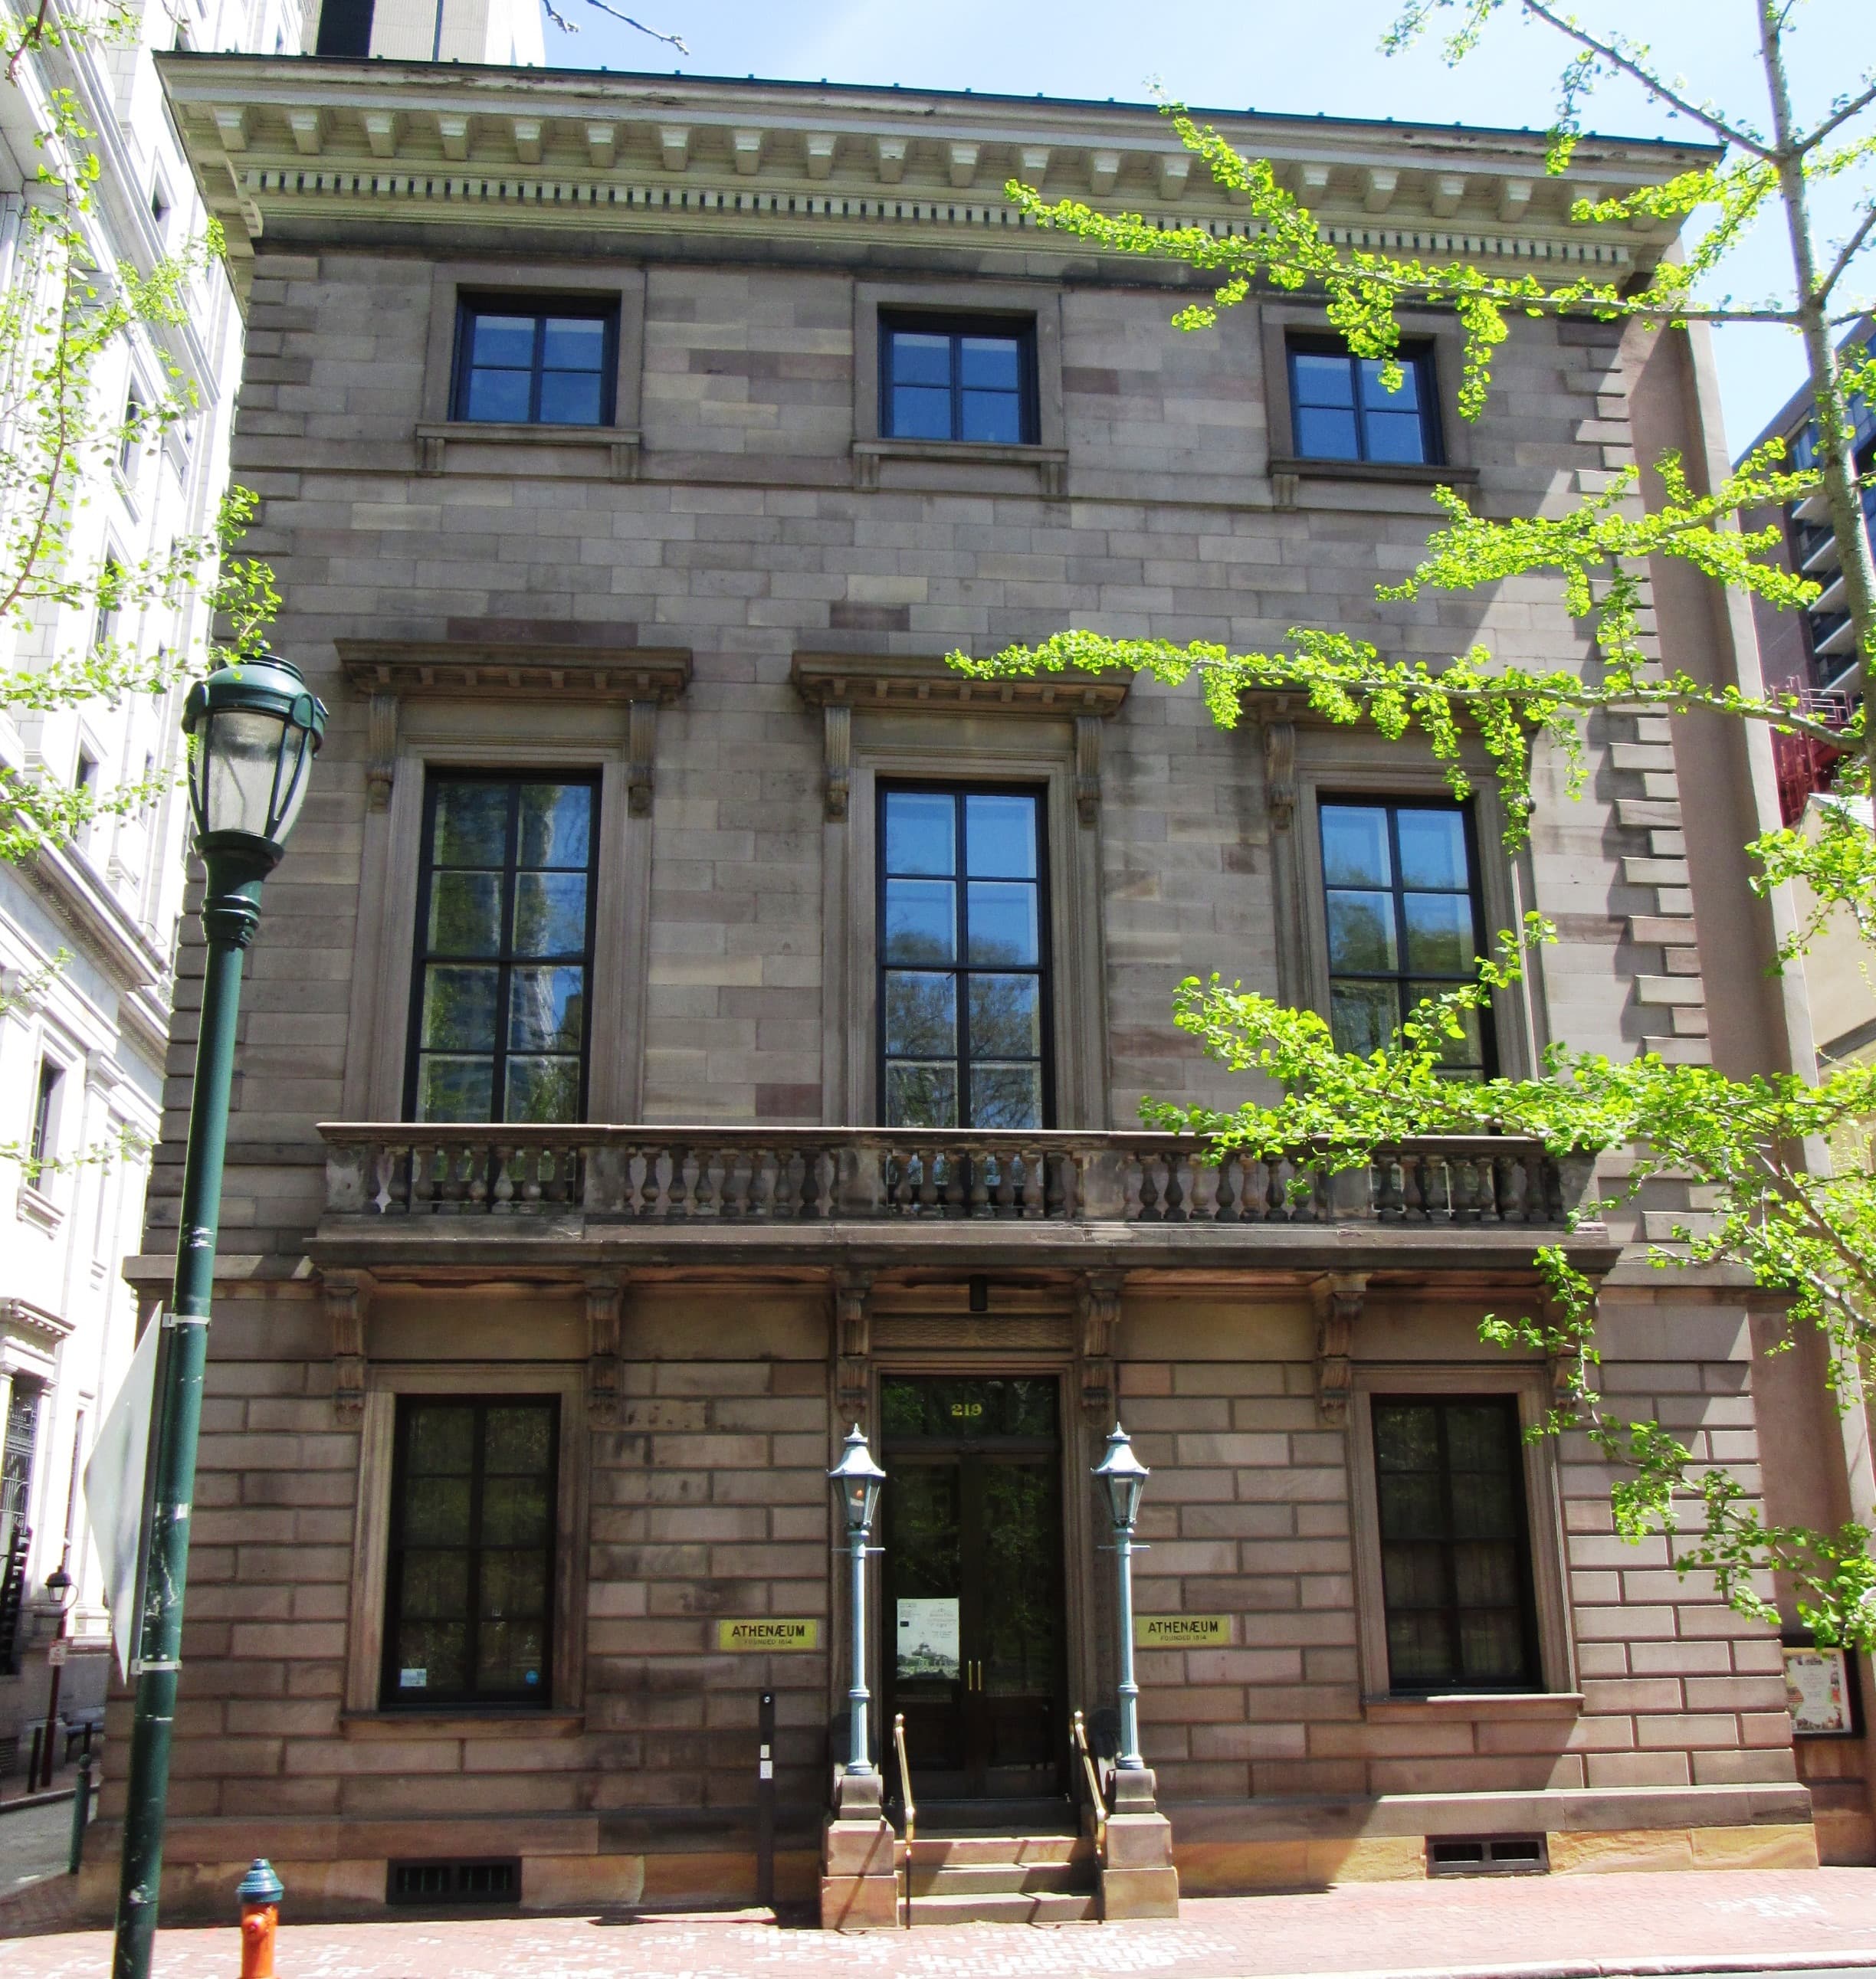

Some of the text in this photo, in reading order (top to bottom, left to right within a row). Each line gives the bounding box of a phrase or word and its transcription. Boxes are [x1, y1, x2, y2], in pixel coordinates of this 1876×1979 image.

[951, 1404, 982, 1416] 219
[732, 1625, 805, 1637] ATHENÆUM
[1148, 1621, 1218, 1633] ATHENÆUM
